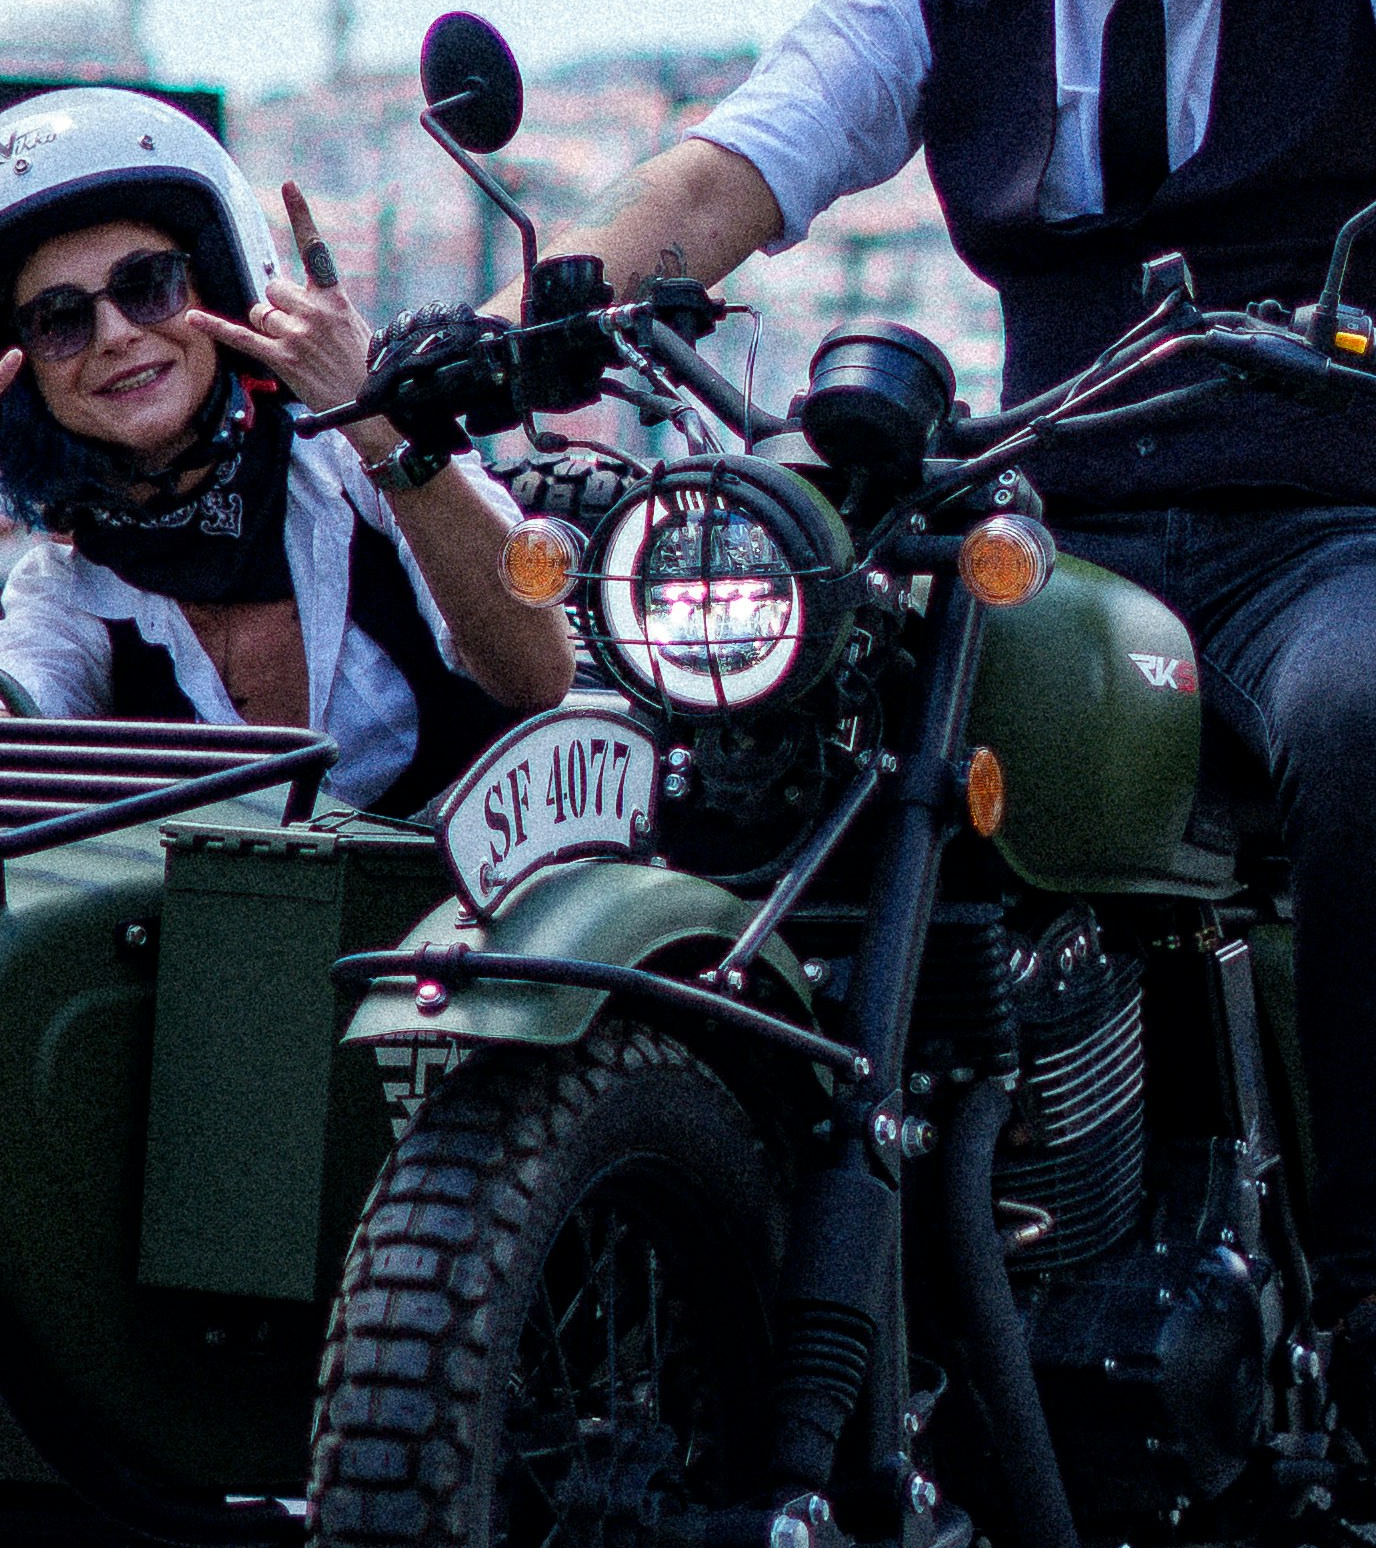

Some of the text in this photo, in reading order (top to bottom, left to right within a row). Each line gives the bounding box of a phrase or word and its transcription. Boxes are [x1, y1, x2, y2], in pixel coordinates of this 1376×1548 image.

[1127, 653, 1195, 693] RKS
[483, 738, 632, 863] SF 4077
